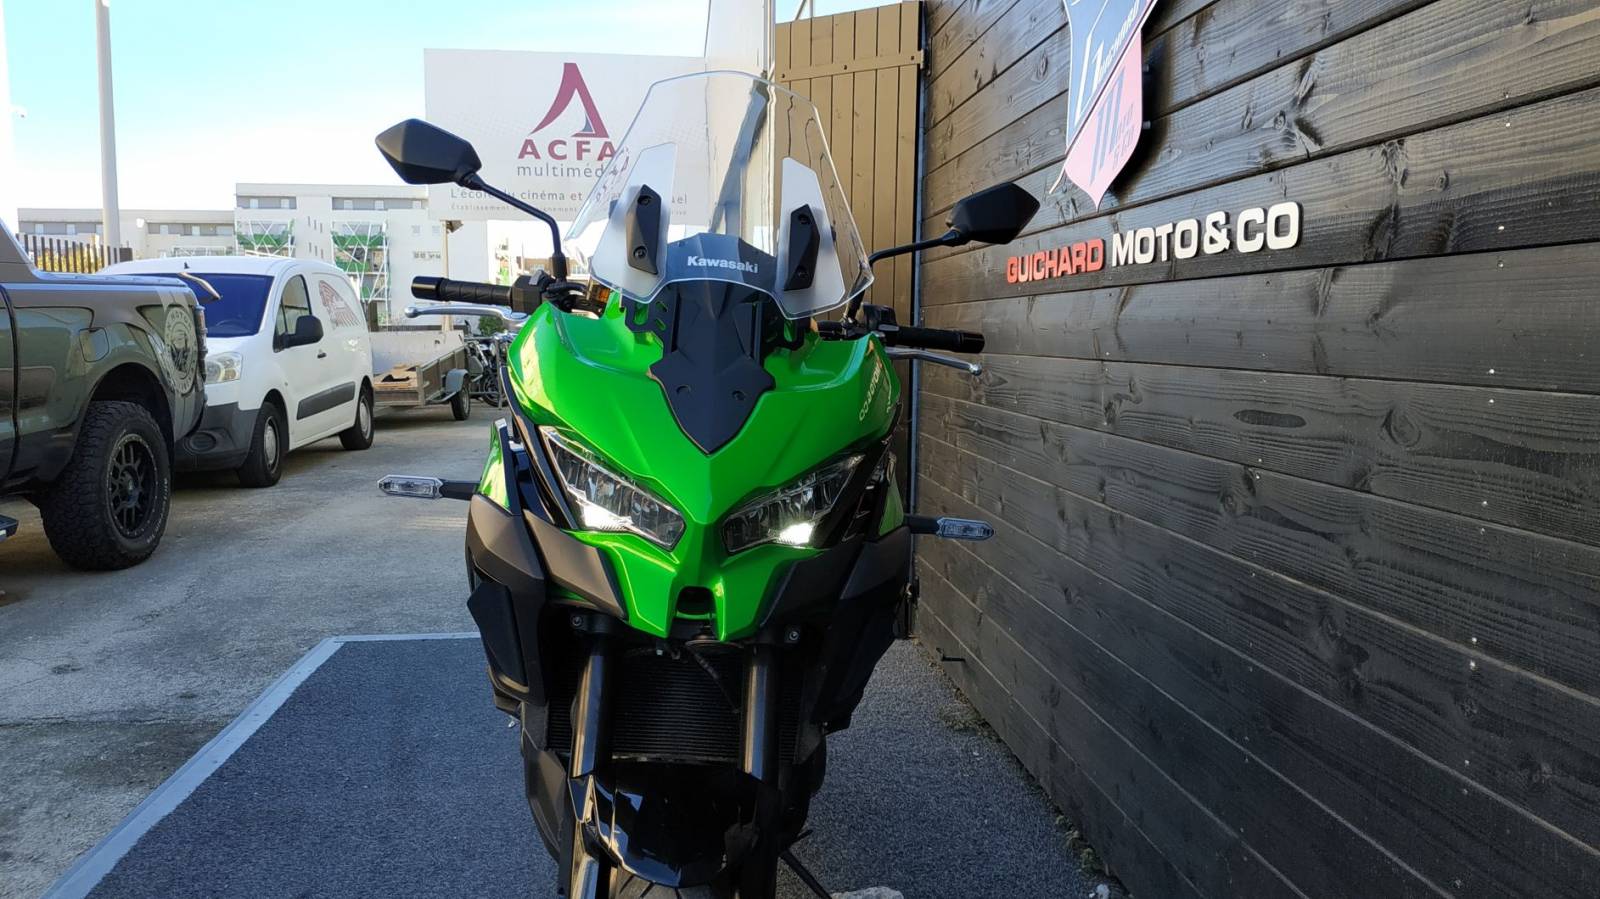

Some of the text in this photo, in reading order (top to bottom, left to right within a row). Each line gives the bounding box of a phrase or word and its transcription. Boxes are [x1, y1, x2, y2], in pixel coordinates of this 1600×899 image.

[517, 138, 617, 161] ACFA
[517, 162, 605, 178] multiméd
[520, 189, 565, 201] cinéma
[570, 191, 583, 201] et
[687, 256, 759, 273] Kawasaki
[1006, 238, 1104, 284] GUICHARD
